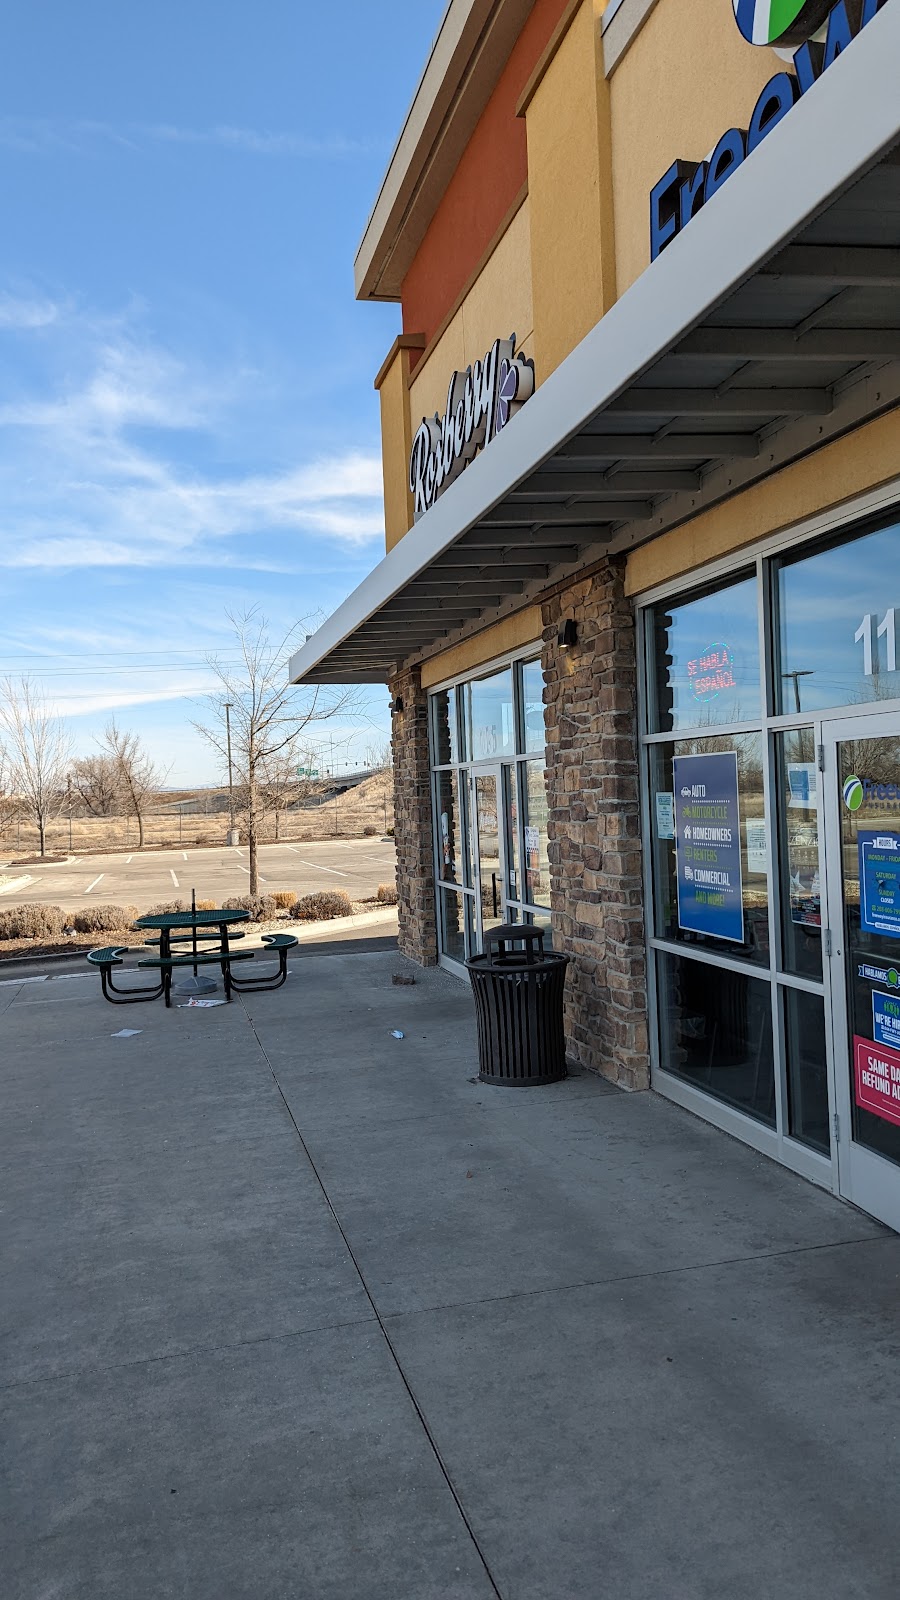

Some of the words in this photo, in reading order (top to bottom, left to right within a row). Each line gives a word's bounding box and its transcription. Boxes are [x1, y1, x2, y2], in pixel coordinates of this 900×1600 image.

[688, 660, 698, 676] SE
[699, 650, 729, 672] HABLA
[695, 670, 736, 694] ESPAÑOL
[691, 784, 706, 798] AUTO
[691, 805, 728, 820] MOTORCYCLE
[692, 826, 732, 842] HOMEOWNERS
[878, 838, 892, 847] HOURS
[693, 847, 718, 862] RENTERS
[694, 868, 731, 886] COMMERCIAL
[876, 872, 897, 880] SATURDAY
[695, 890, 707, 904] AND
[707, 892, 725, 907] MORE!
[878, 889, 895, 897] SUNDAY
[864, 966, 887, 981] HABLAMOS
[875, 1012, 891, 1027] WE'RE
[867, 1056, 889, 1079] SAME
[862, 1070, 890, 1096] REFUND
